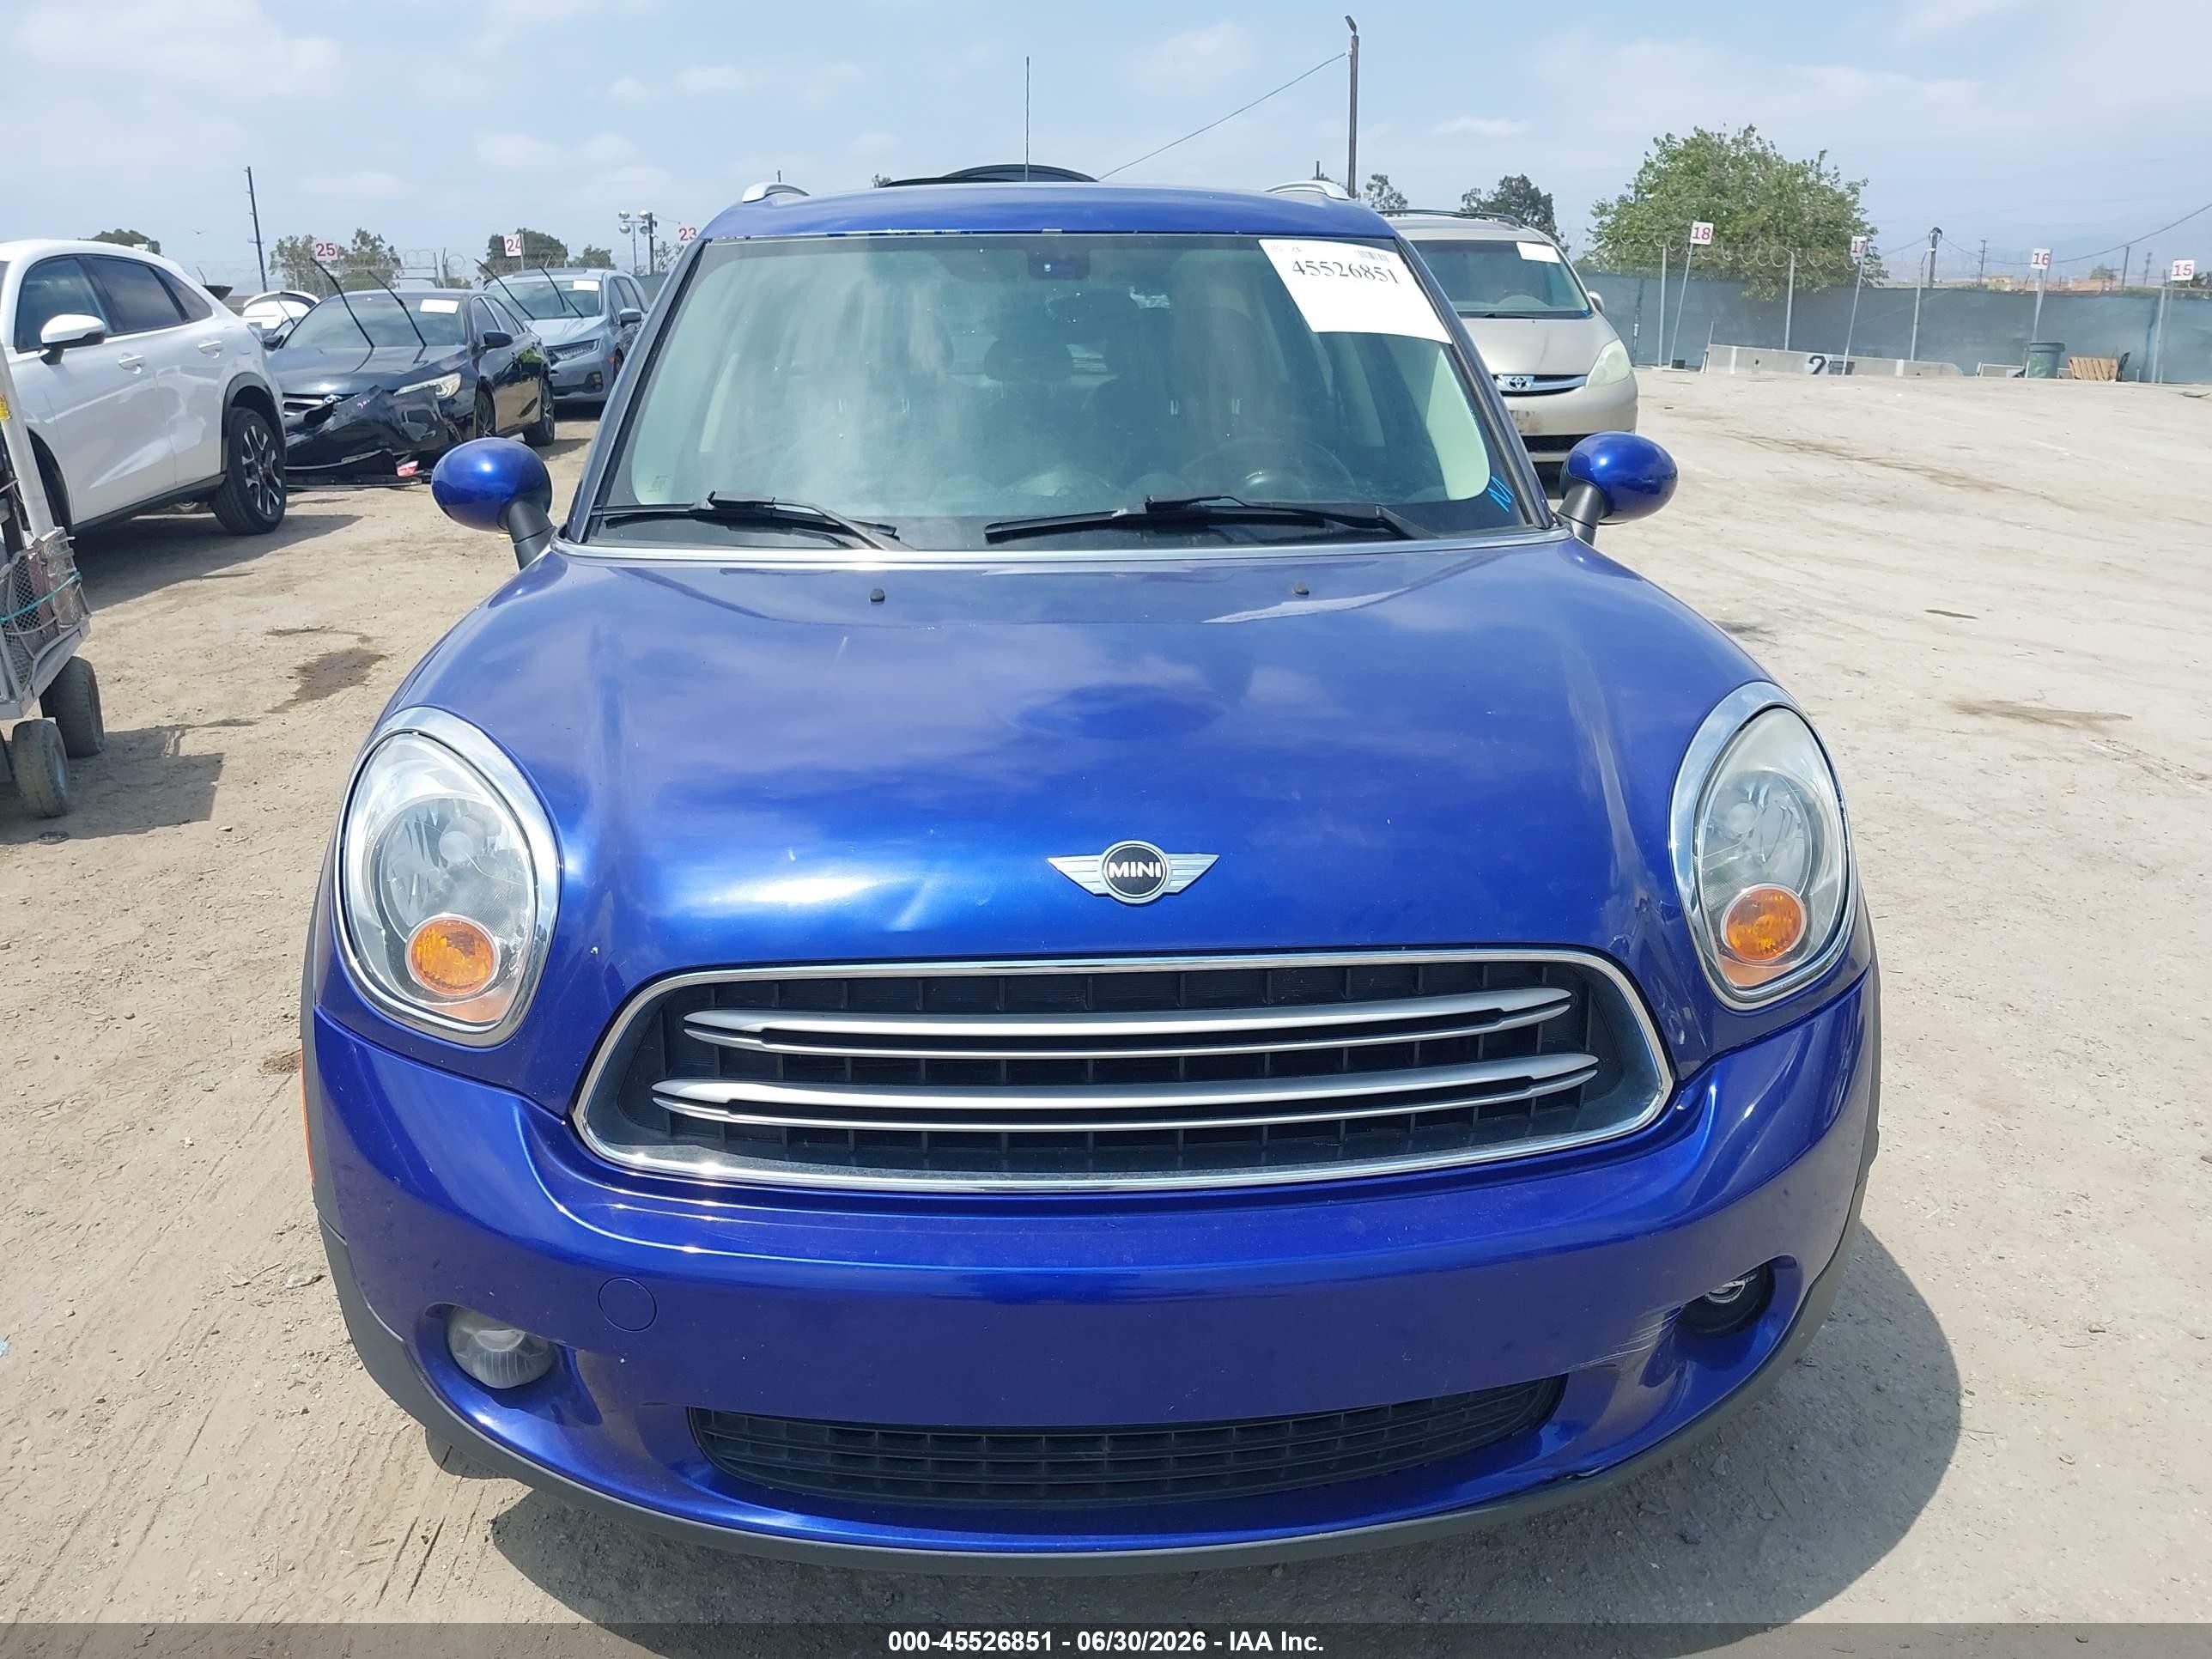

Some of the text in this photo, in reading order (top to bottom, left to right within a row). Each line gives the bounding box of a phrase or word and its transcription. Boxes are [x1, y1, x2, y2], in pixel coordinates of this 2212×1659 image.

[678, 227, 696, 241] 23
[1692, 227, 1711, 240] 18
[315, 242, 336, 257] 25
[507, 239, 521, 252] 24
[1852, 240, 1866, 253] 17
[2033, 252, 2050, 265] 16
[1291, 260, 1400, 284] 45526851
[2172, 264, 2192, 276] 15
[1109, 861, 1161, 878] MINI
